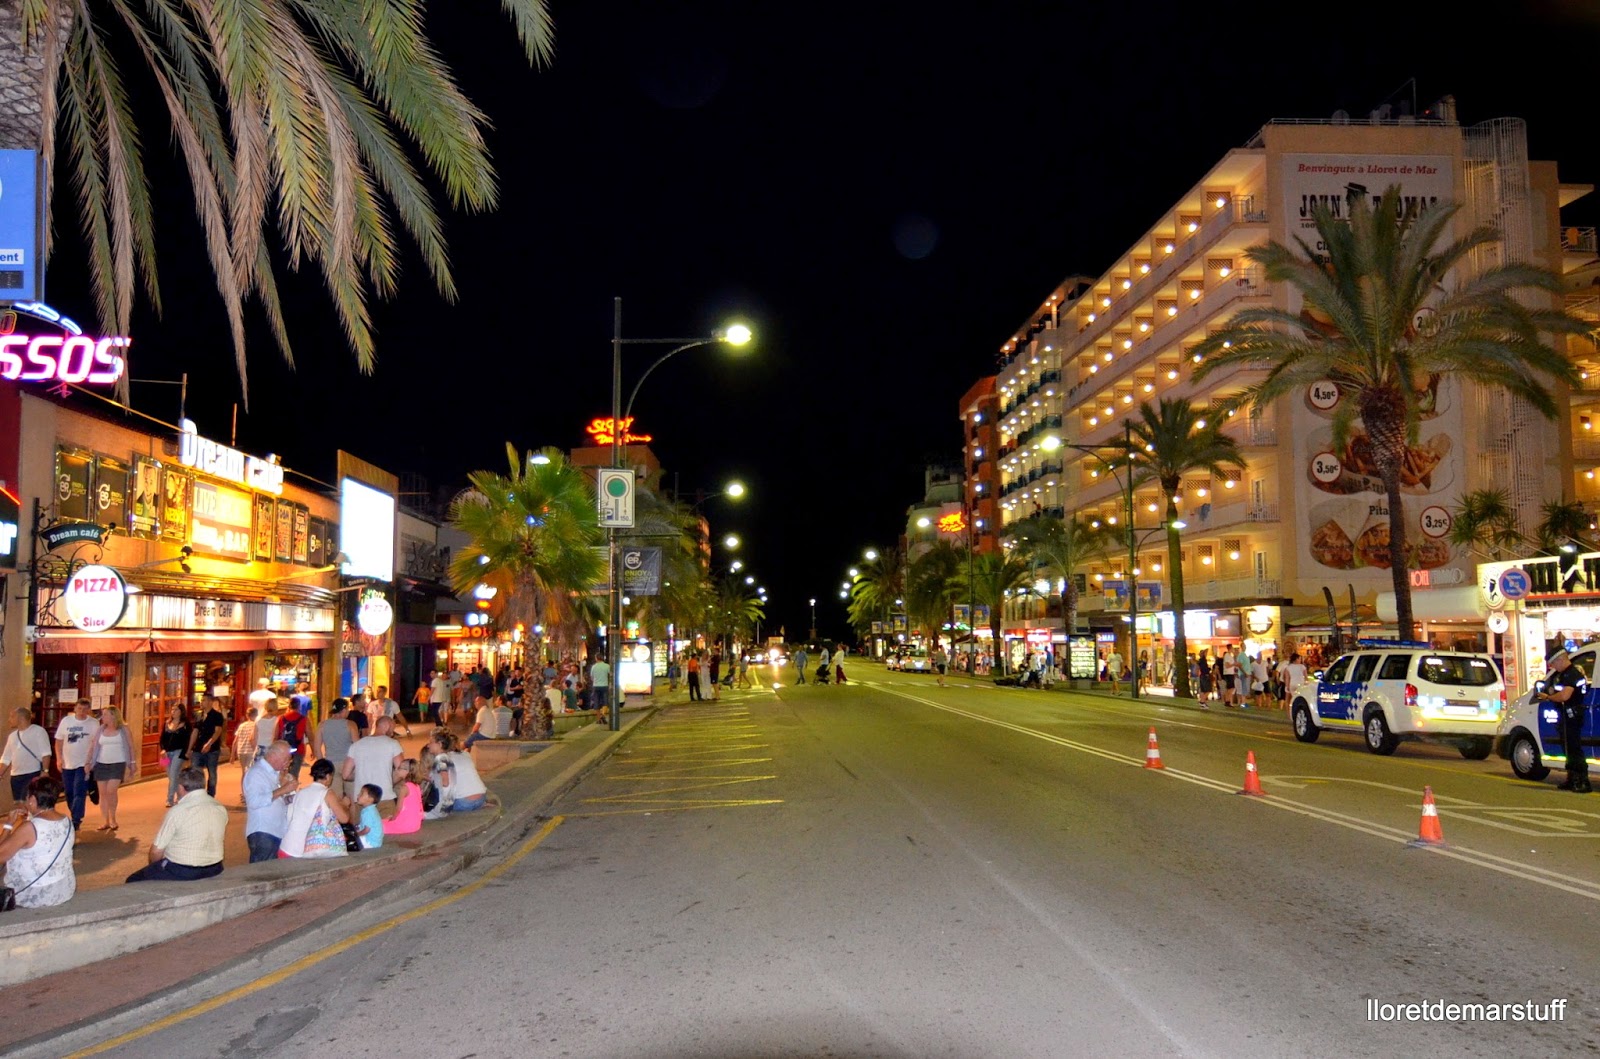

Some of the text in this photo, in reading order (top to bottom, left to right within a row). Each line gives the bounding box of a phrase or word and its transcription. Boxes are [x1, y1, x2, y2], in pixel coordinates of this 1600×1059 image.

[1298, 163, 1355, 175] Benvinguts
[1367, 165, 1398, 174] Lloret
[1400, 165, 1412, 174] de
[1415, 166, 1438, 175] Mar
[50, 527, 100, 544] Dream café
[74, 578, 118, 594] PIZZA
[194, 601, 216, 617] Dream
